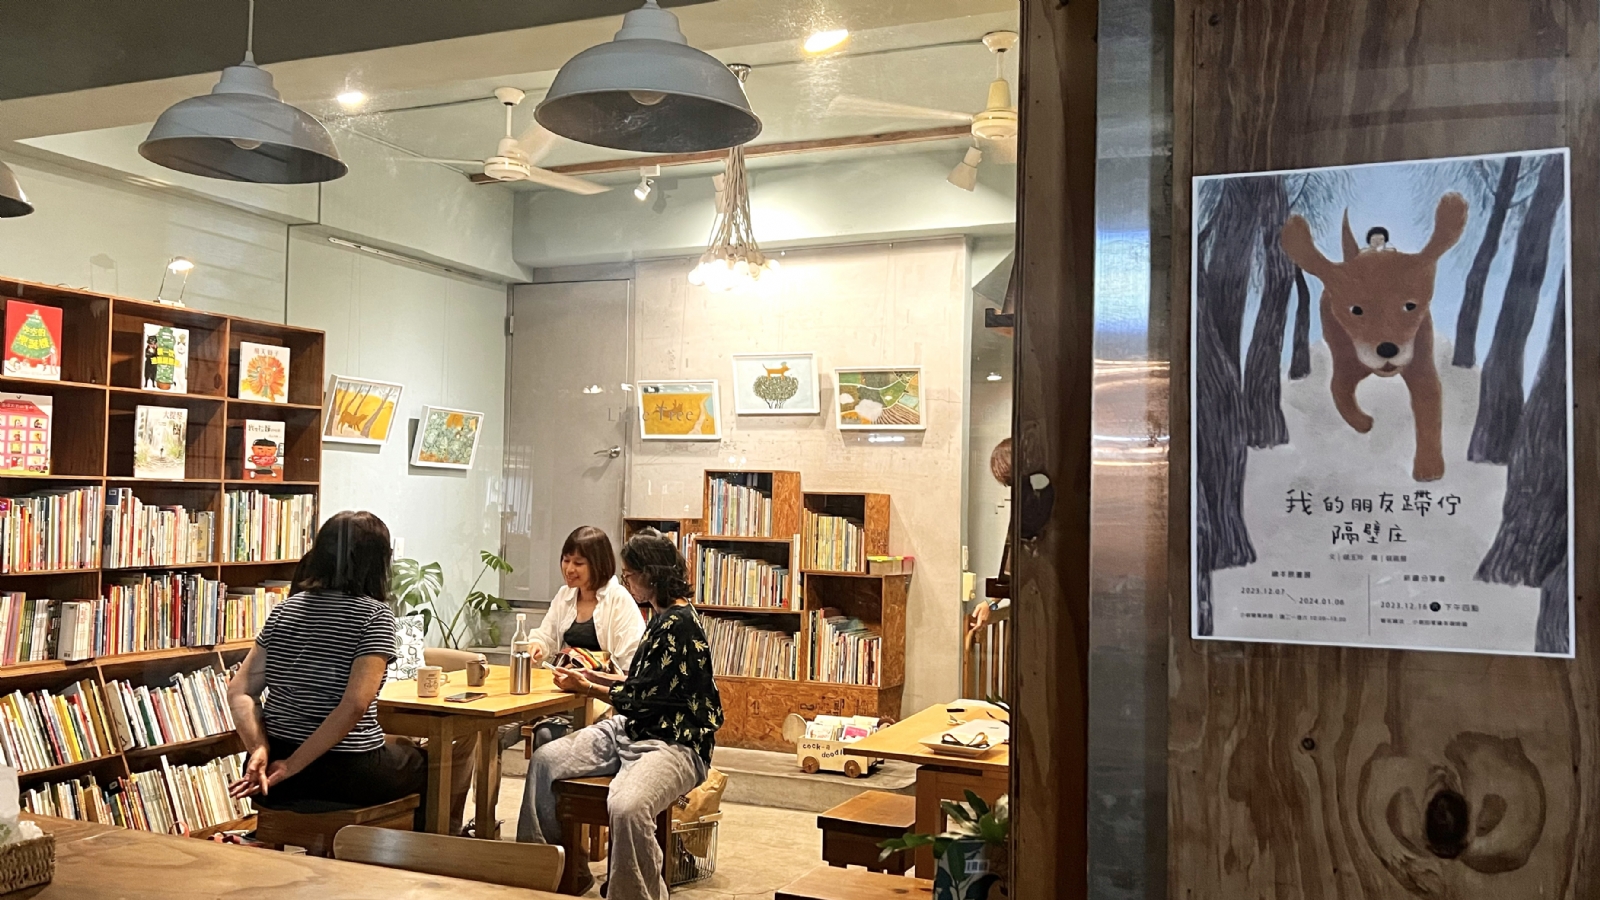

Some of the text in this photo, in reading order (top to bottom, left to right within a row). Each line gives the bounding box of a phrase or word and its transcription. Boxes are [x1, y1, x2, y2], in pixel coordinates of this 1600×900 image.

[608, 406, 650, 422] Lile
[1332, 520, 1407, 545] 隔壁庄
[821, 749, 844, 758] doodl
